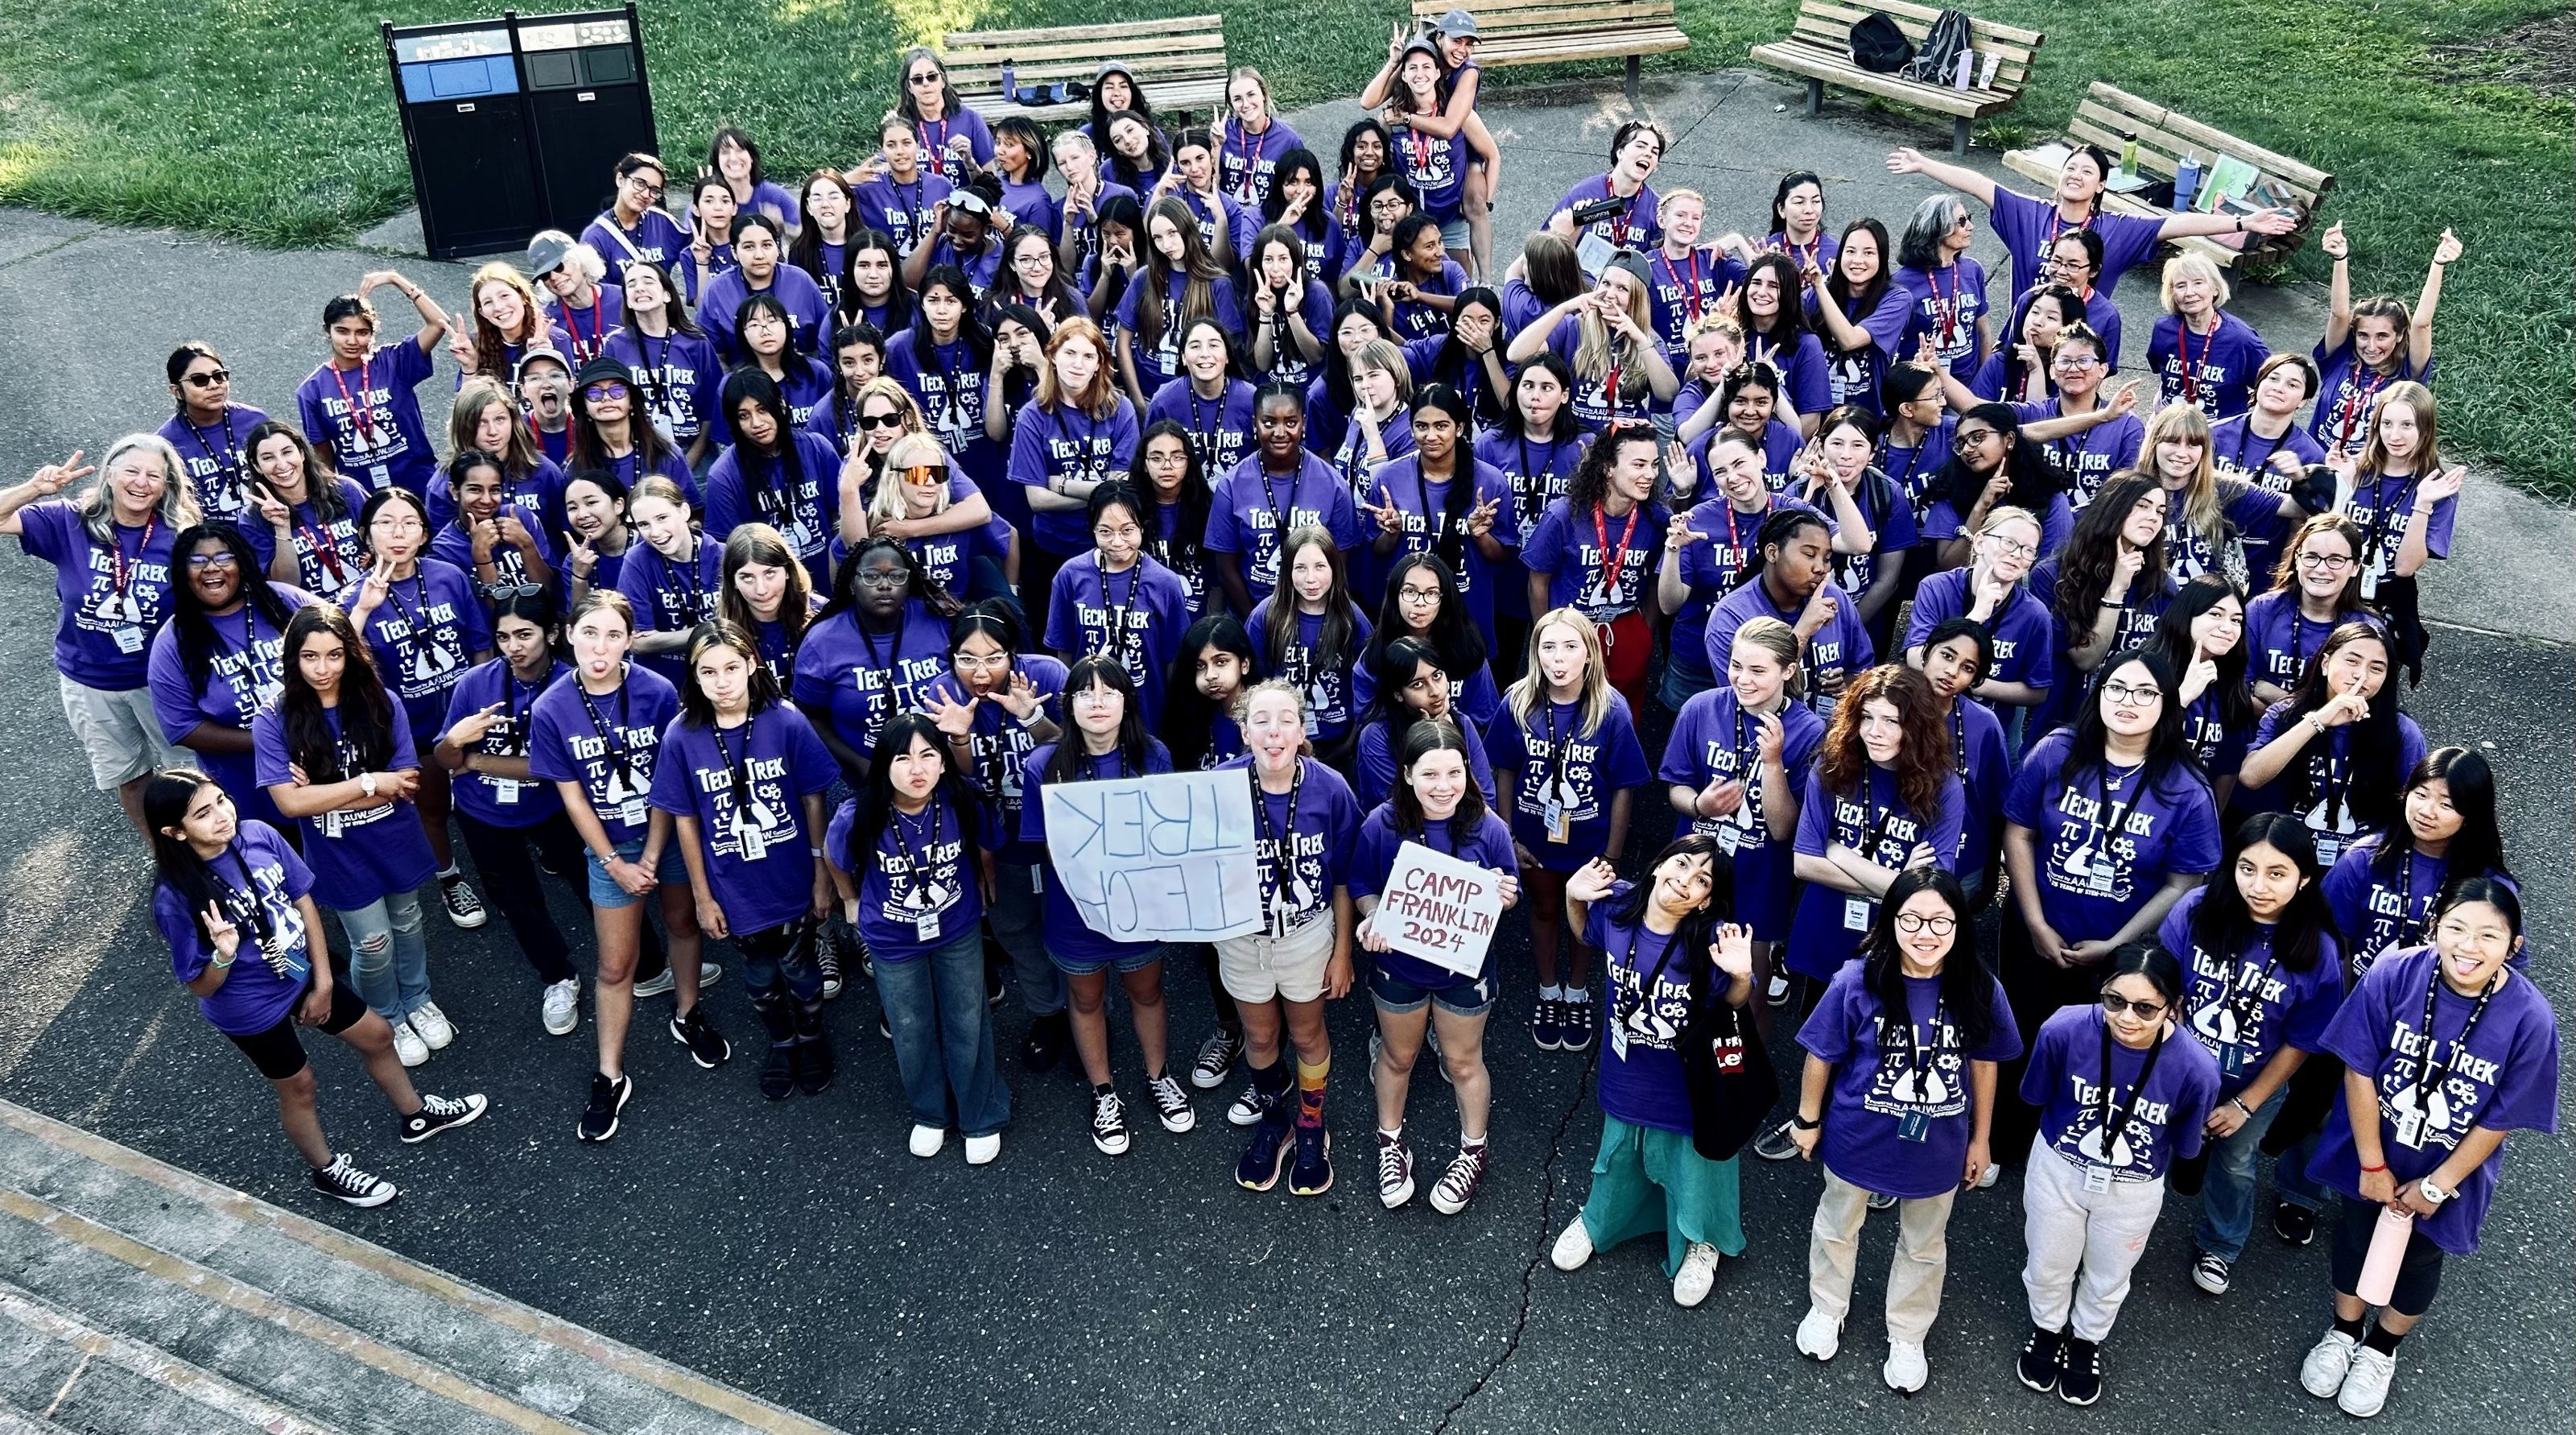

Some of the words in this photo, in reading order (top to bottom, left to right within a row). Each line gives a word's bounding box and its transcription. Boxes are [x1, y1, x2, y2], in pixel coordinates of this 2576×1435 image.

[915, 209, 935, 223] TRE
[1300, 241, 1325, 258] TREK
[2038, 241, 2052, 258] TE
[1922, 297, 1950, 316] TEH
[1410, 310, 1436, 331] TEH
[663, 364, 696, 386] TREK
[918, 373, 945, 391] TECH
[791, 407, 813, 424] REK
[1216, 428, 1244, 448] TREK
[228, 448, 247, 467] TR
[2079, 451, 2111, 471] TREK
[1546, 473, 1571, 493] TRE
[1290, 507, 1322, 527] TREK
[1437, 512, 1470, 535] TEK
[89, 548, 116, 573] TEC
[129, 558, 169, 583] TREK
[504, 551, 523, 571] TR
[924, 544, 958, 566] TREK
[1714, 544, 1748, 568] TECH
[1076, 604, 1108, 627] TECH
[2125, 608, 2160, 633] TREK
[254, 637, 284, 664] TRE
[1286, 647, 1309, 663] ECH
[1813, 642, 1840, 665] TREK
[1992, 639, 2017, 659] REK
[898, 657, 942, 681] TREK
[1006, 728, 1036, 751] TRE
[1567, 734, 1600, 763] TREK
[744, 757, 786, 782] TREK
[1835, 795, 1864, 827] TECH
[2058, 786, 2101, 823] TECH
[1053, 784, 1243, 859] TREK
[1256, 840, 1281, 861] ECH
[1291, 832, 1324, 858] TREK
[253, 862, 285, 891] TR
[1406, 867, 1483, 905] CAMP
[2071, 876, 2089, 888] AA
[1065, 859, 1253, 935] TECH
[1385, 889, 1495, 937] FRANKLIN
[1402, 922, 1465, 953] 2024
[1653, 974, 1691, 1002] TREK
[2449, 1040, 2500, 1087] TREK
[1902, 1102, 1936, 1114] AAUW
[2128, 1087, 2169, 1125] REK
